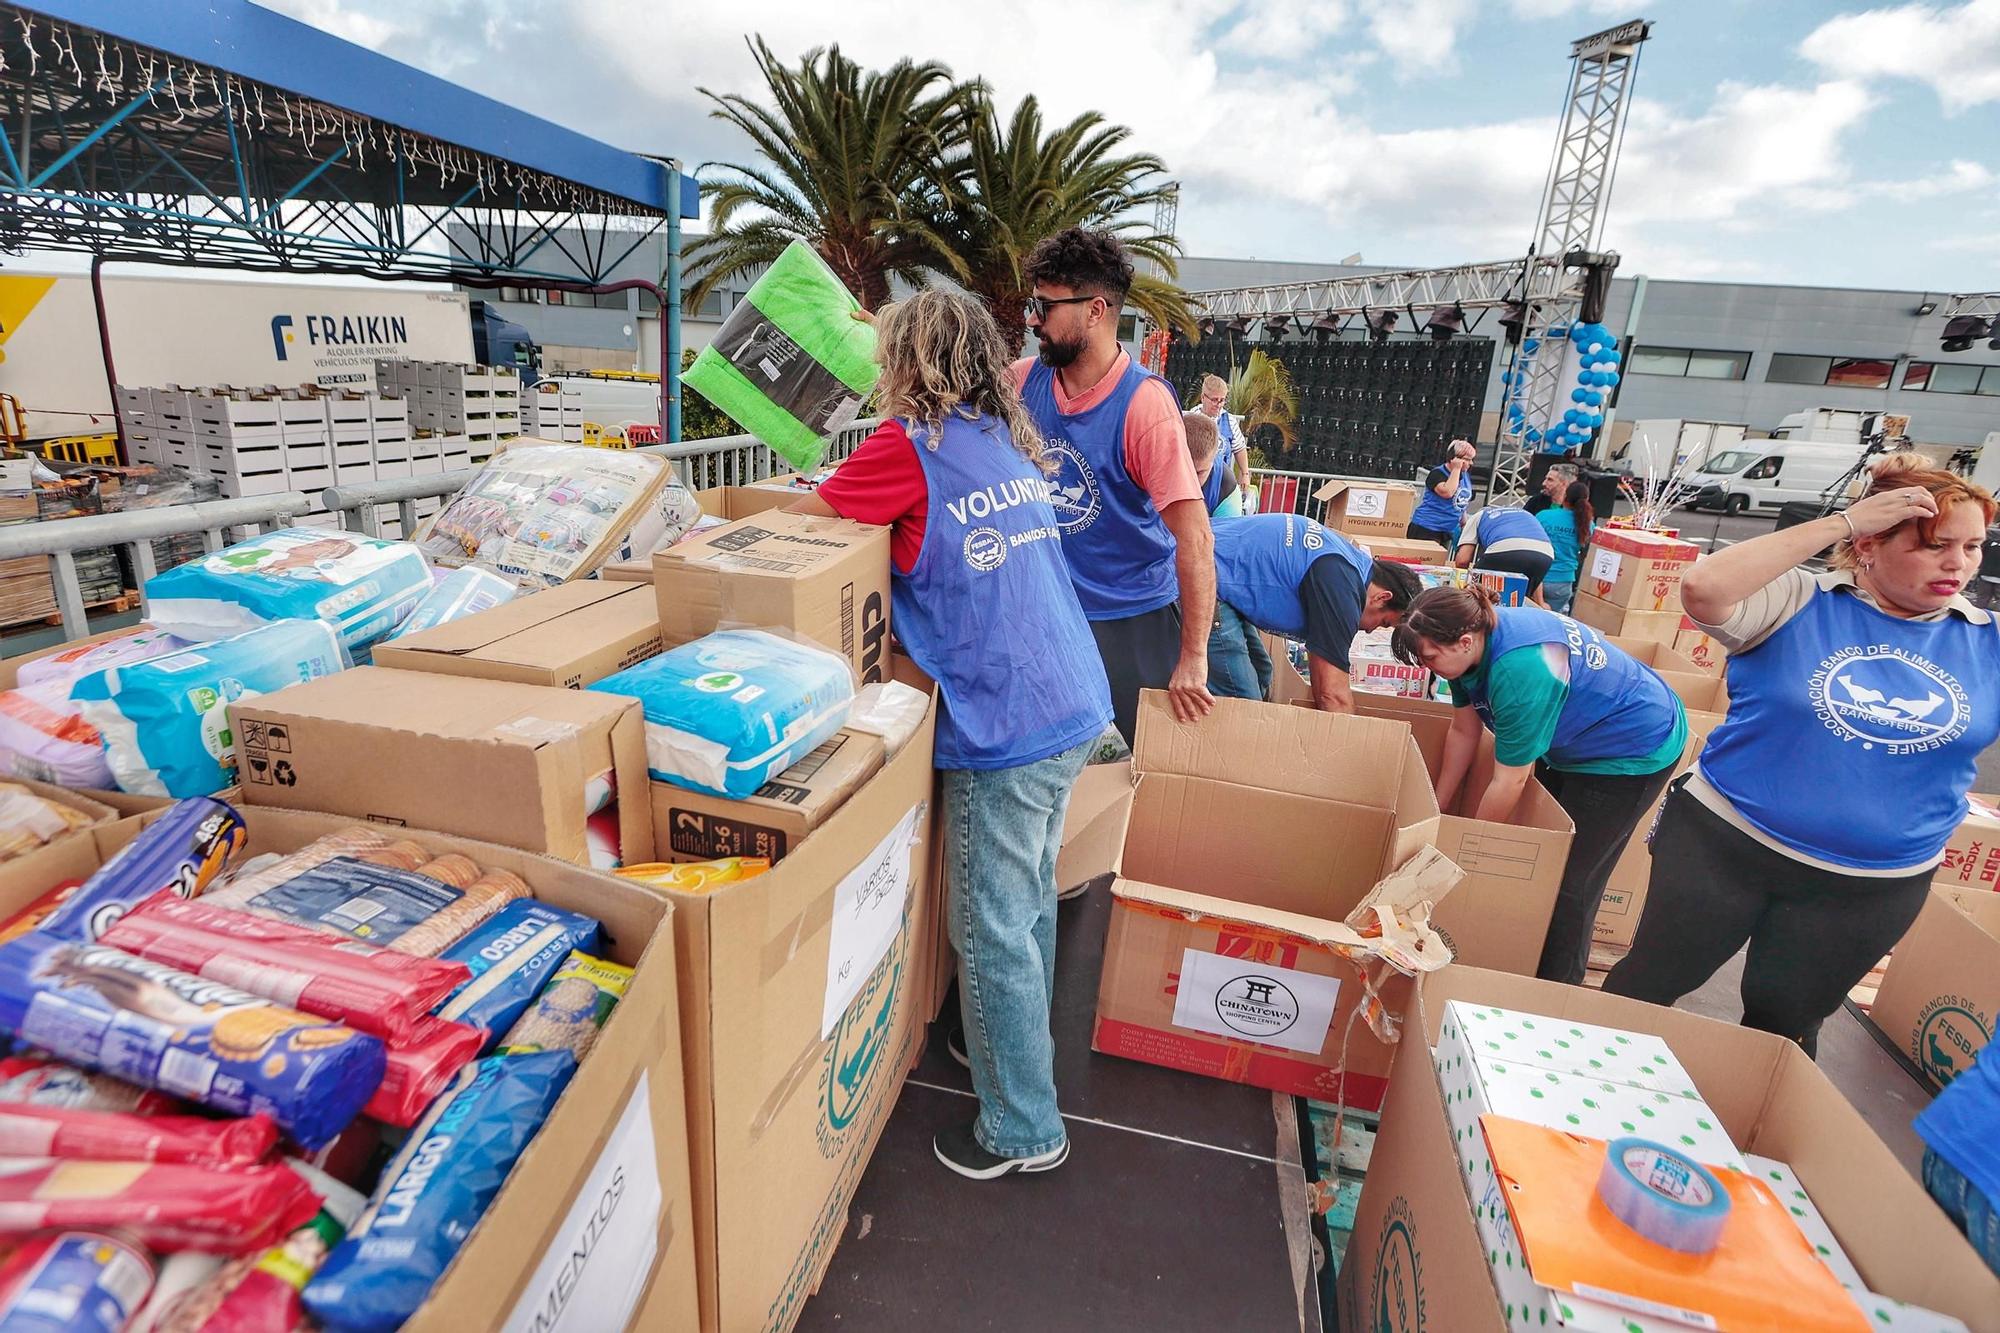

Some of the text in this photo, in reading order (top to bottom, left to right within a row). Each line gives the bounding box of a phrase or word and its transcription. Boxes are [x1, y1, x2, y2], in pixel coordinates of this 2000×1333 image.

[306, 315, 408, 346] FRAIKIN
[313, 356, 360, 368] VEHÍCULOS
[1348, 518, 1377, 528] HYGIENIC
[1379, 520, 1390, 528] PET
[703, 674, 738, 688] 4
[1808, 643, 1971, 755] ASOCIACIÓN BANCO DE ALIMENTOS DE TENERIFE
[1838, 706, 1930, 736] BANCOTEIDE
[245, 748, 268, 758] FRAGILE
[677, 812, 704, 834] 2
[714, 824, 731, 855] 3-6
[855, 855, 892, 904] VARIOS
[479, 916, 548, 961] LARGO
[518, 931, 571, 979] ARROZ
[846, 944, 899, 1040] FESBAL
[1920, 994, 1958, 1020] BANCOS
[1960, 997, 1975, 1013] DE
[1219, 999, 1291, 1020] CHINATOWN
[1226, 1011, 1281, 1027] SHOPPING CENTER
[373, 1134, 451, 1228] LARGO
